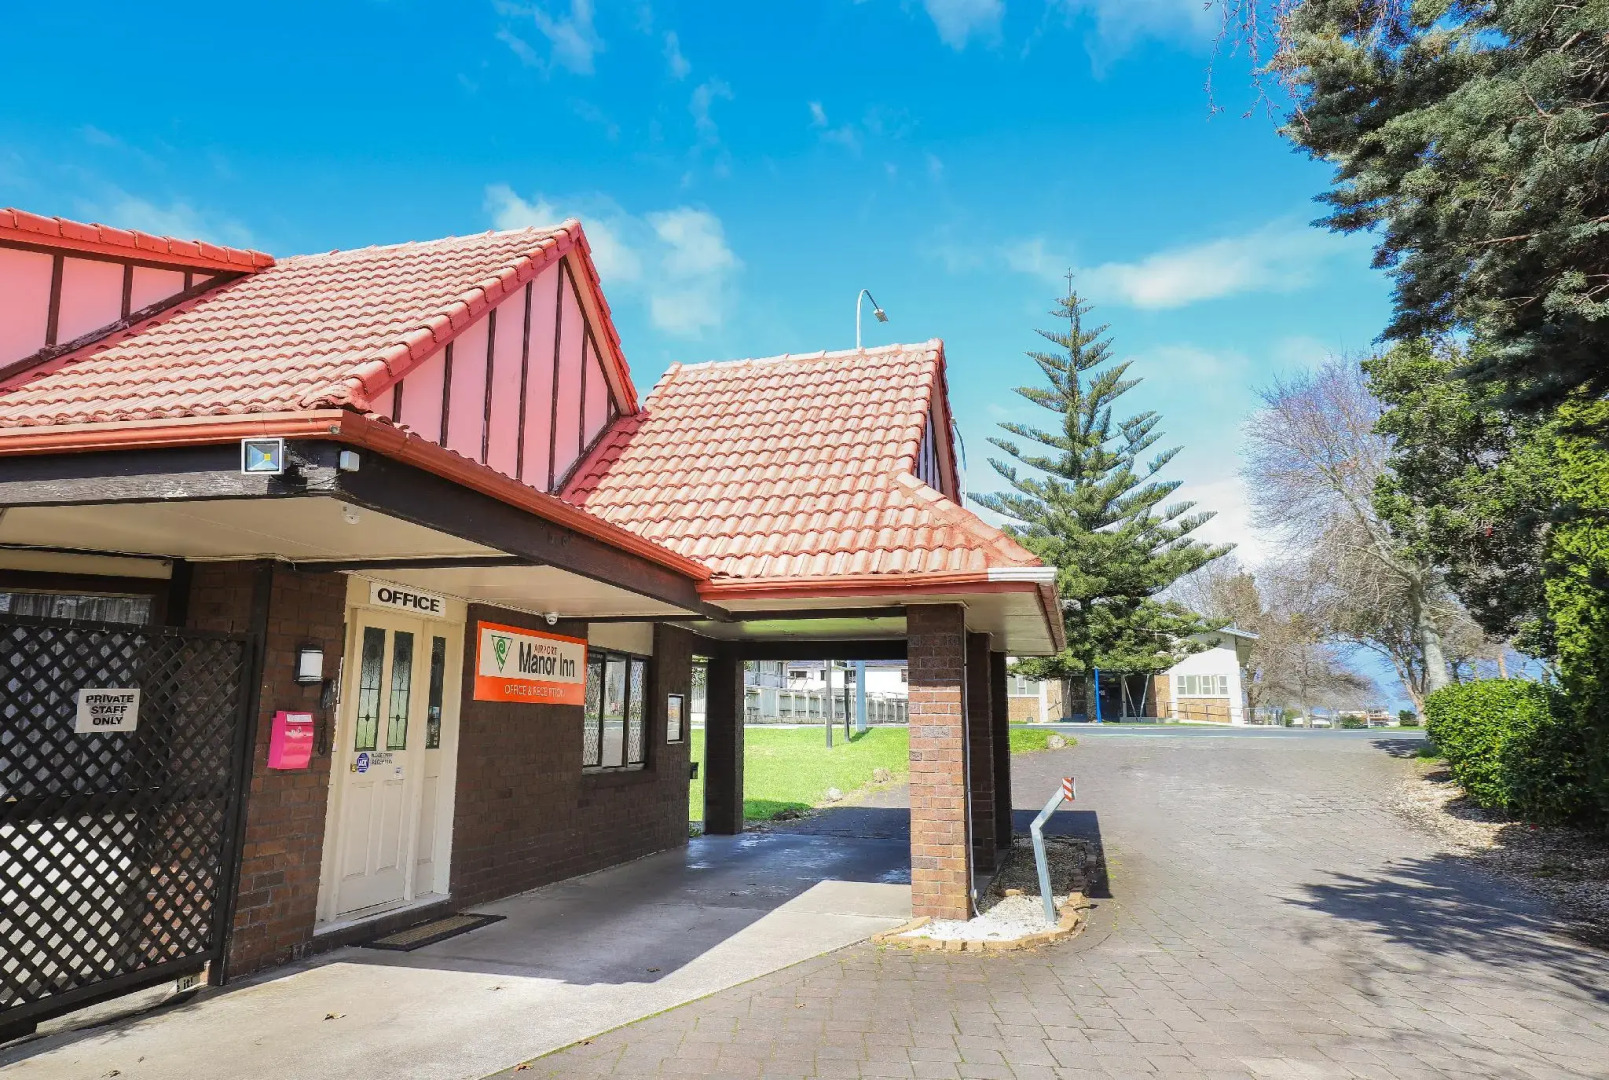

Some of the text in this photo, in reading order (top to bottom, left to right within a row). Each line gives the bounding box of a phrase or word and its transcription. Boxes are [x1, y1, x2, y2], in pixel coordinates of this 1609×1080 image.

[378, 588, 440, 612] OFFICE
[534, 643, 558, 656] AIRPORT
[518, 641, 575, 677] Manor Inn
[504, 684, 526, 696] OFFICE
[532, 686, 566, 698] RECEPTION
[85, 694, 134, 703] PRIVATE
[91, 705, 128, 714] STAFF
[92, 716, 123, 725] ONLY
